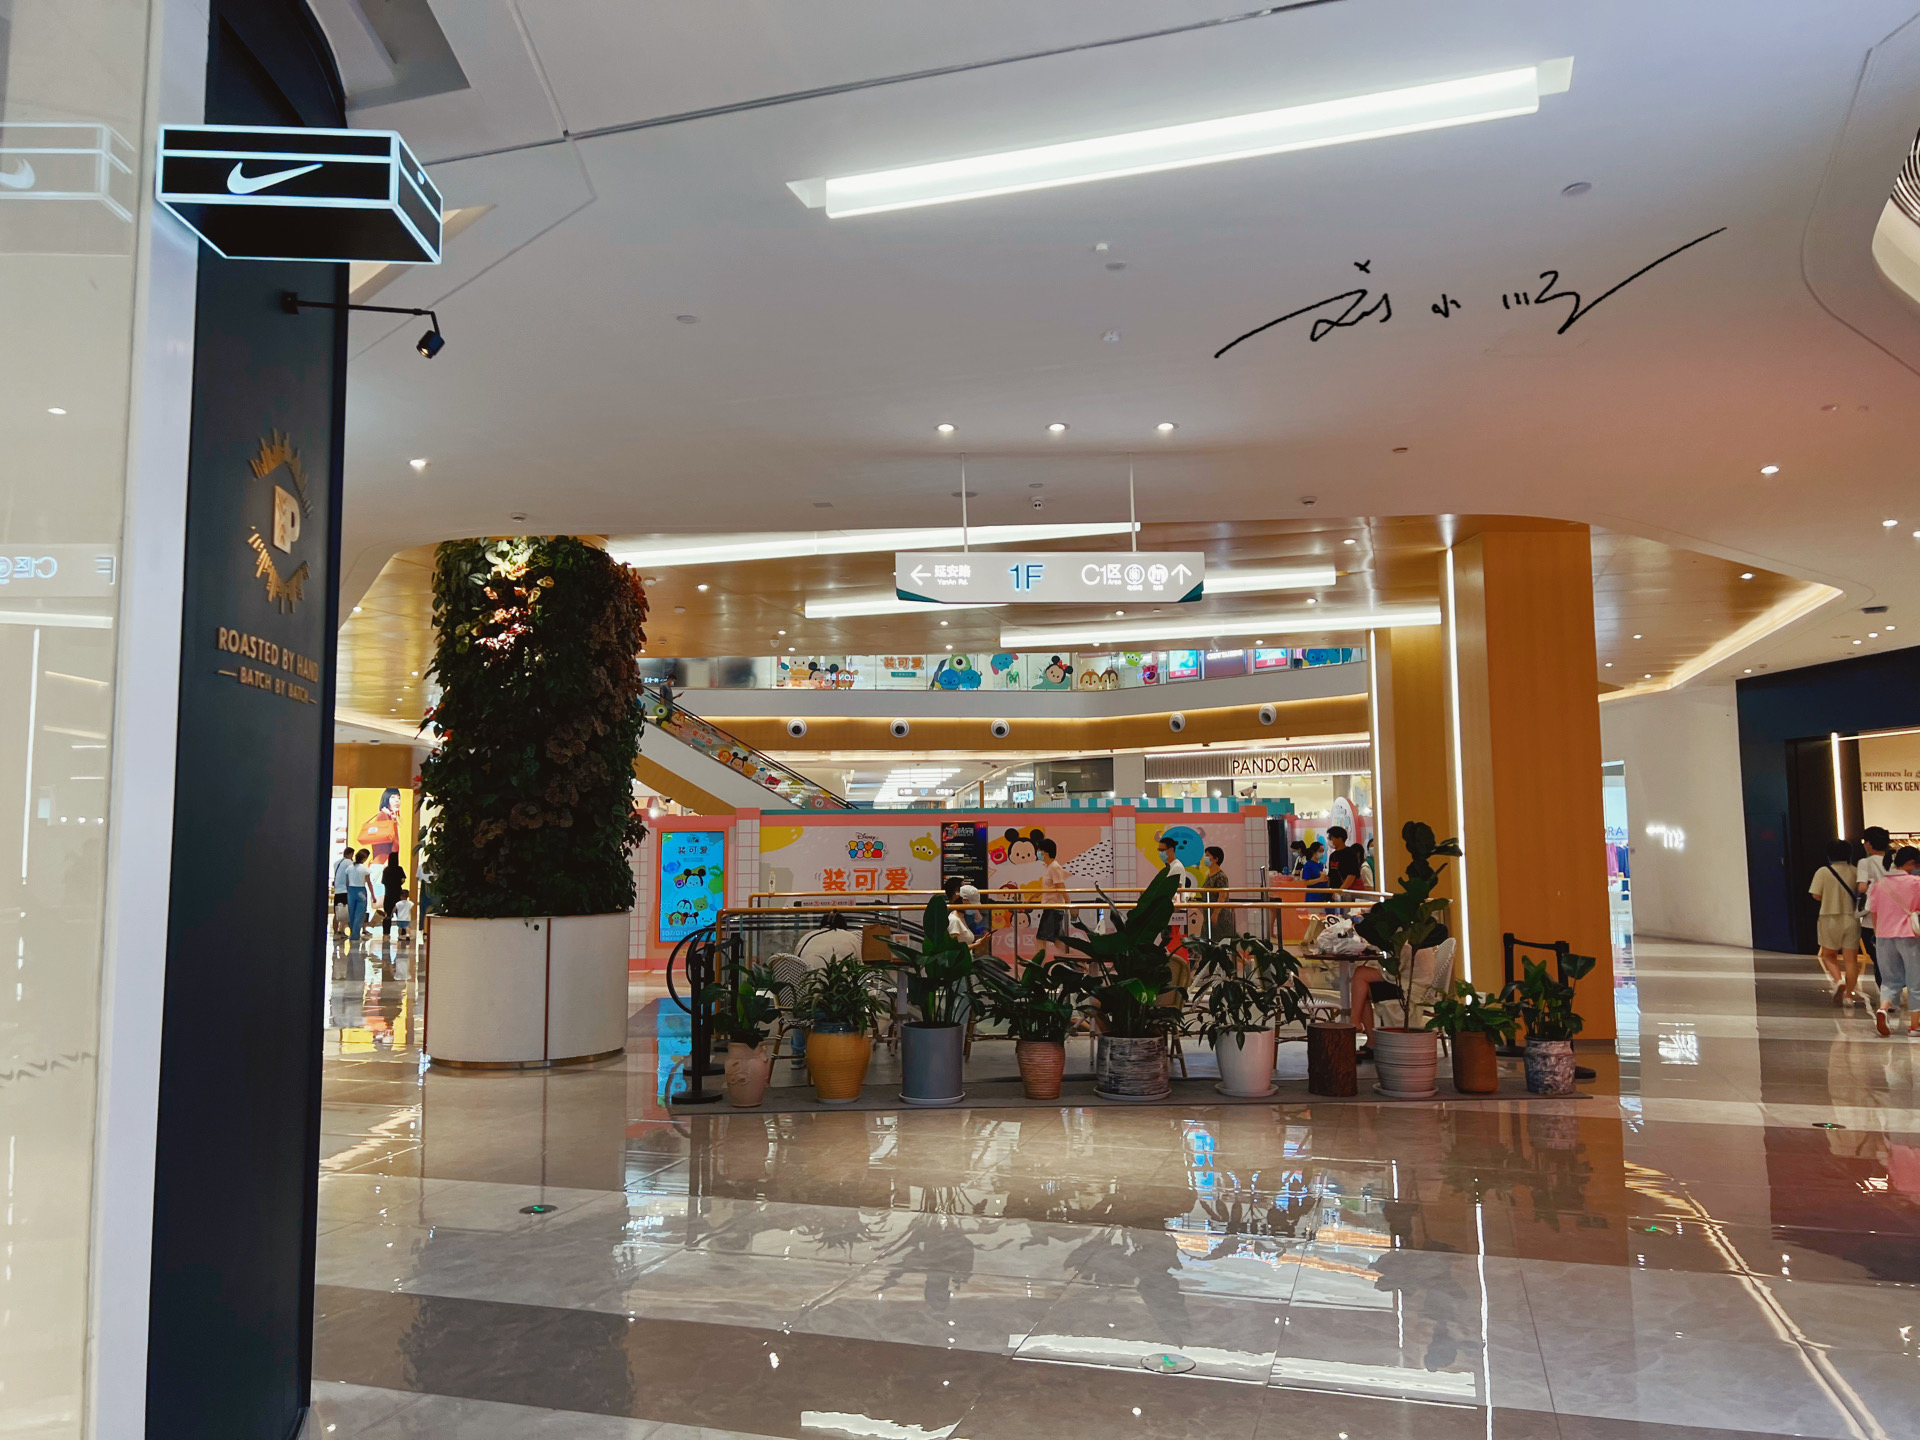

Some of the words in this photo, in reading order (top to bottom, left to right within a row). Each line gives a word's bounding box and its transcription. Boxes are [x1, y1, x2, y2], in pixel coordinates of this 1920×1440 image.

[934, 564, 971, 578] 延安路
[1009, 563, 1044, 591] 1F
[217, 626, 279, 666] ROASTED
[281, 647, 294, 671] BY
[296, 654, 319, 683] HAND
[239, 666, 271, 690] BATCH
[274, 676, 286, 695] BY
[287, 681, 309, 703] BATCH
[1232, 756, 1316, 774] PANDORA
[1904, 769, 1913, 777] la
[1869, 782, 1884, 791] THE
[1885, 782, 1903, 791] IKKS
[1904, 782, 1920, 791] GEN
[855, 831, 879, 841] Disney
[822, 866, 909, 891] 装可爱
